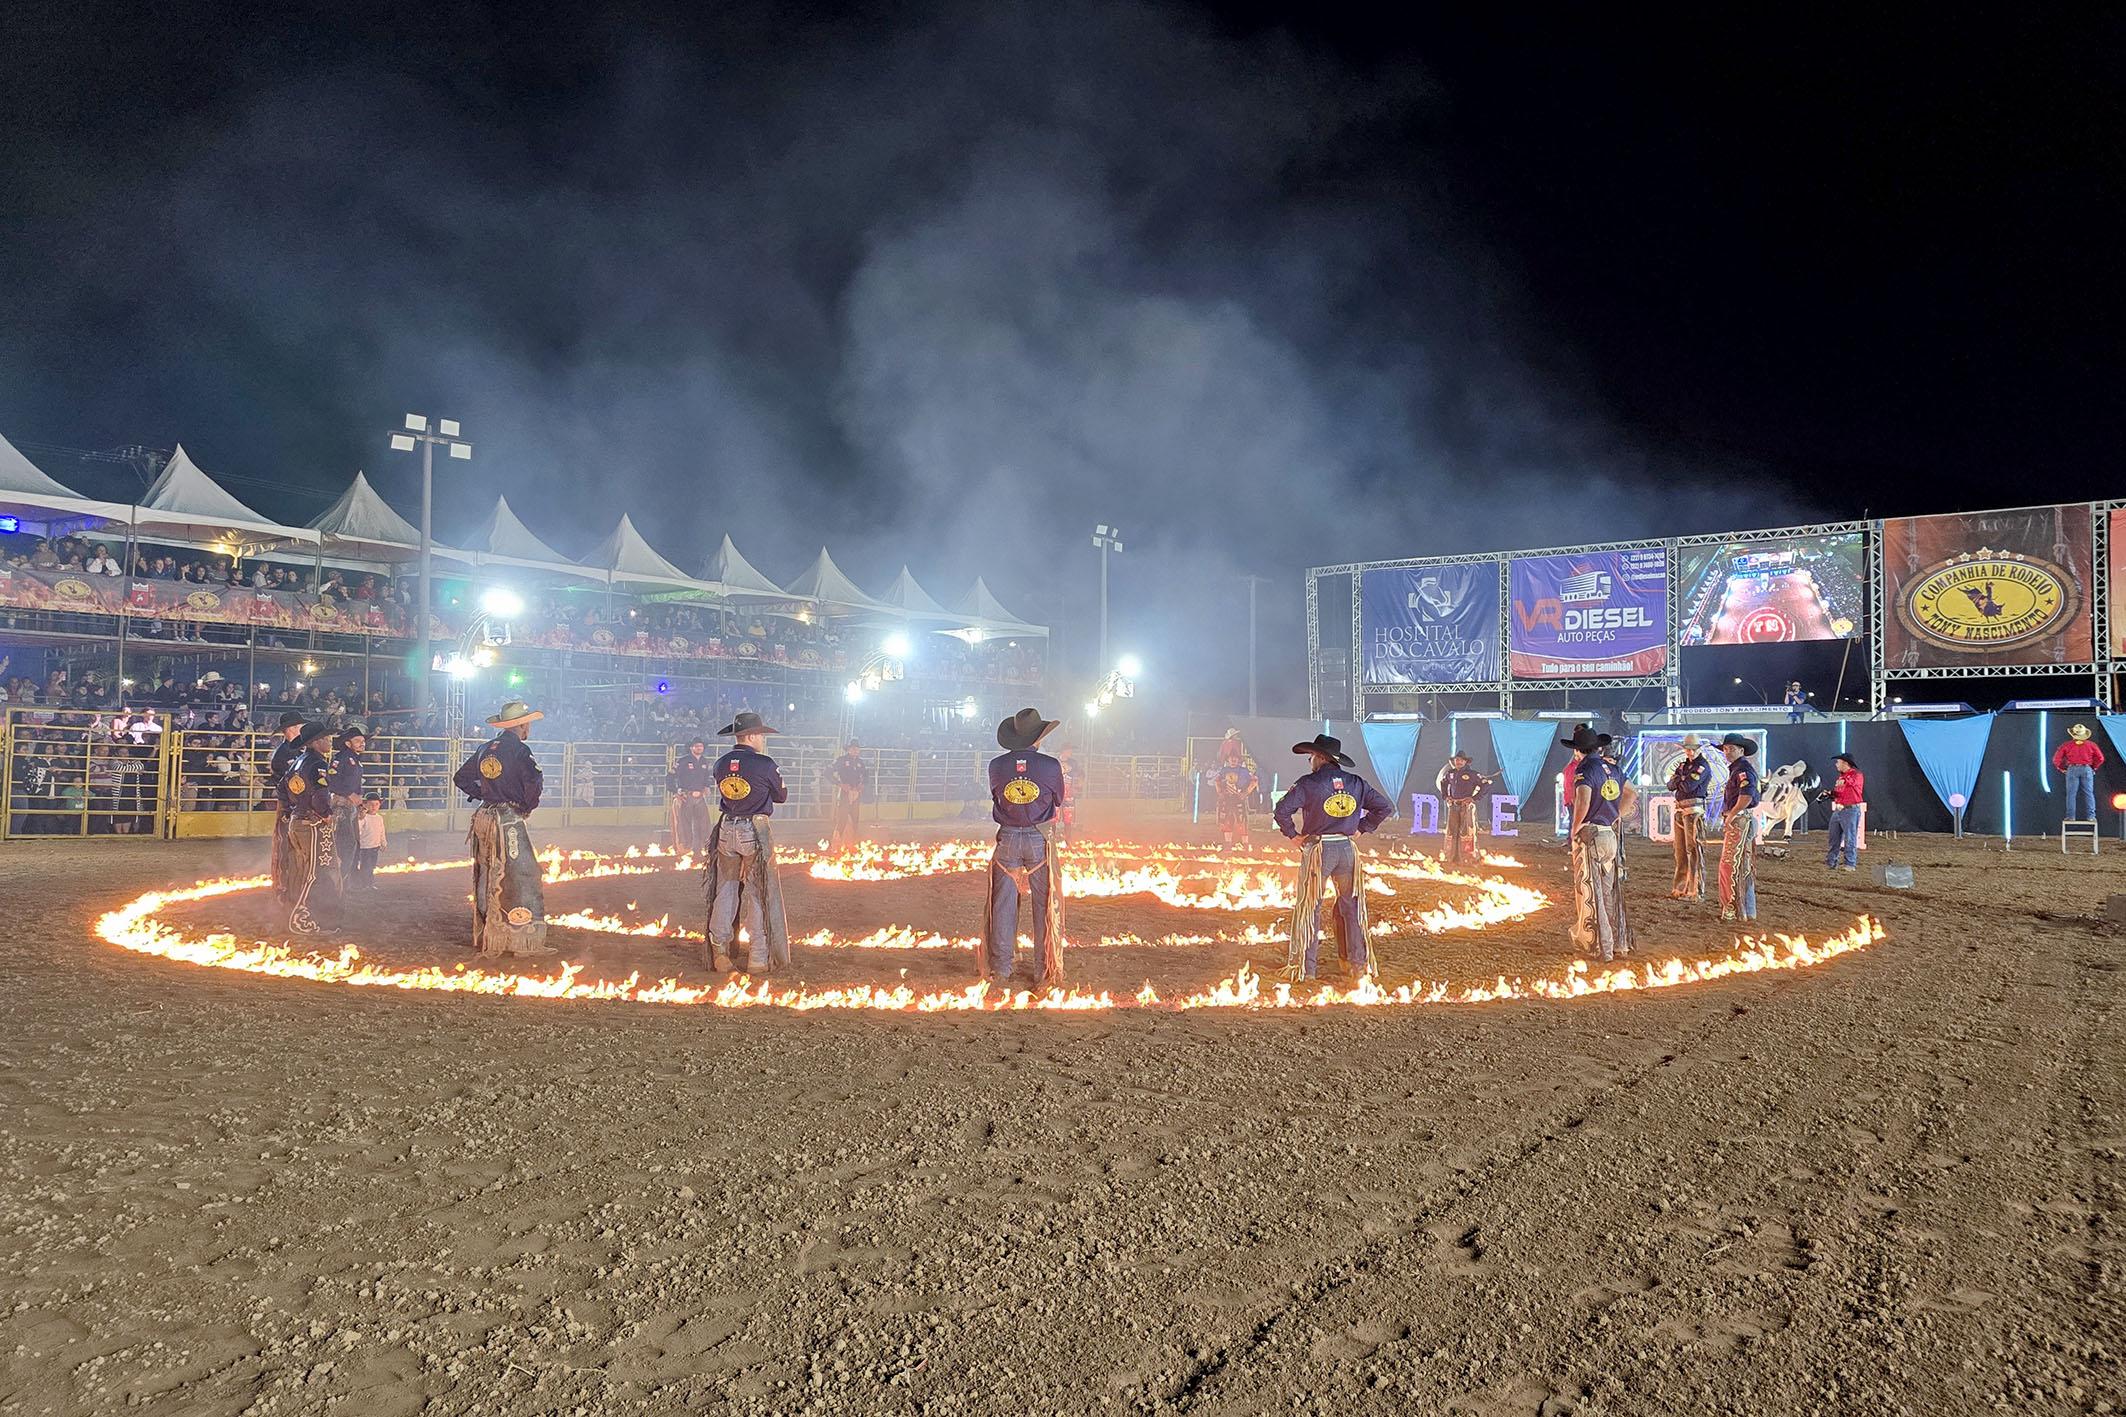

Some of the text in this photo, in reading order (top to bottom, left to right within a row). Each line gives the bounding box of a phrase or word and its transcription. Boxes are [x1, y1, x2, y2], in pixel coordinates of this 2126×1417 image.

[1921, 564, 2054, 601] COMPANHIA DE RODEIO
[1514, 598, 1654, 632] VR DIESEL
[1924, 607, 2049, 640] TONY NASCIMENTO
[1375, 639, 1485, 658] DO CAVALO
[1557, 630, 1616, 644] AUTO PEÇAS
[1541, 663, 1559, 673] Tudo
[1559, 663, 1576, 674] para
[1582, 662, 1595, 672] seu
